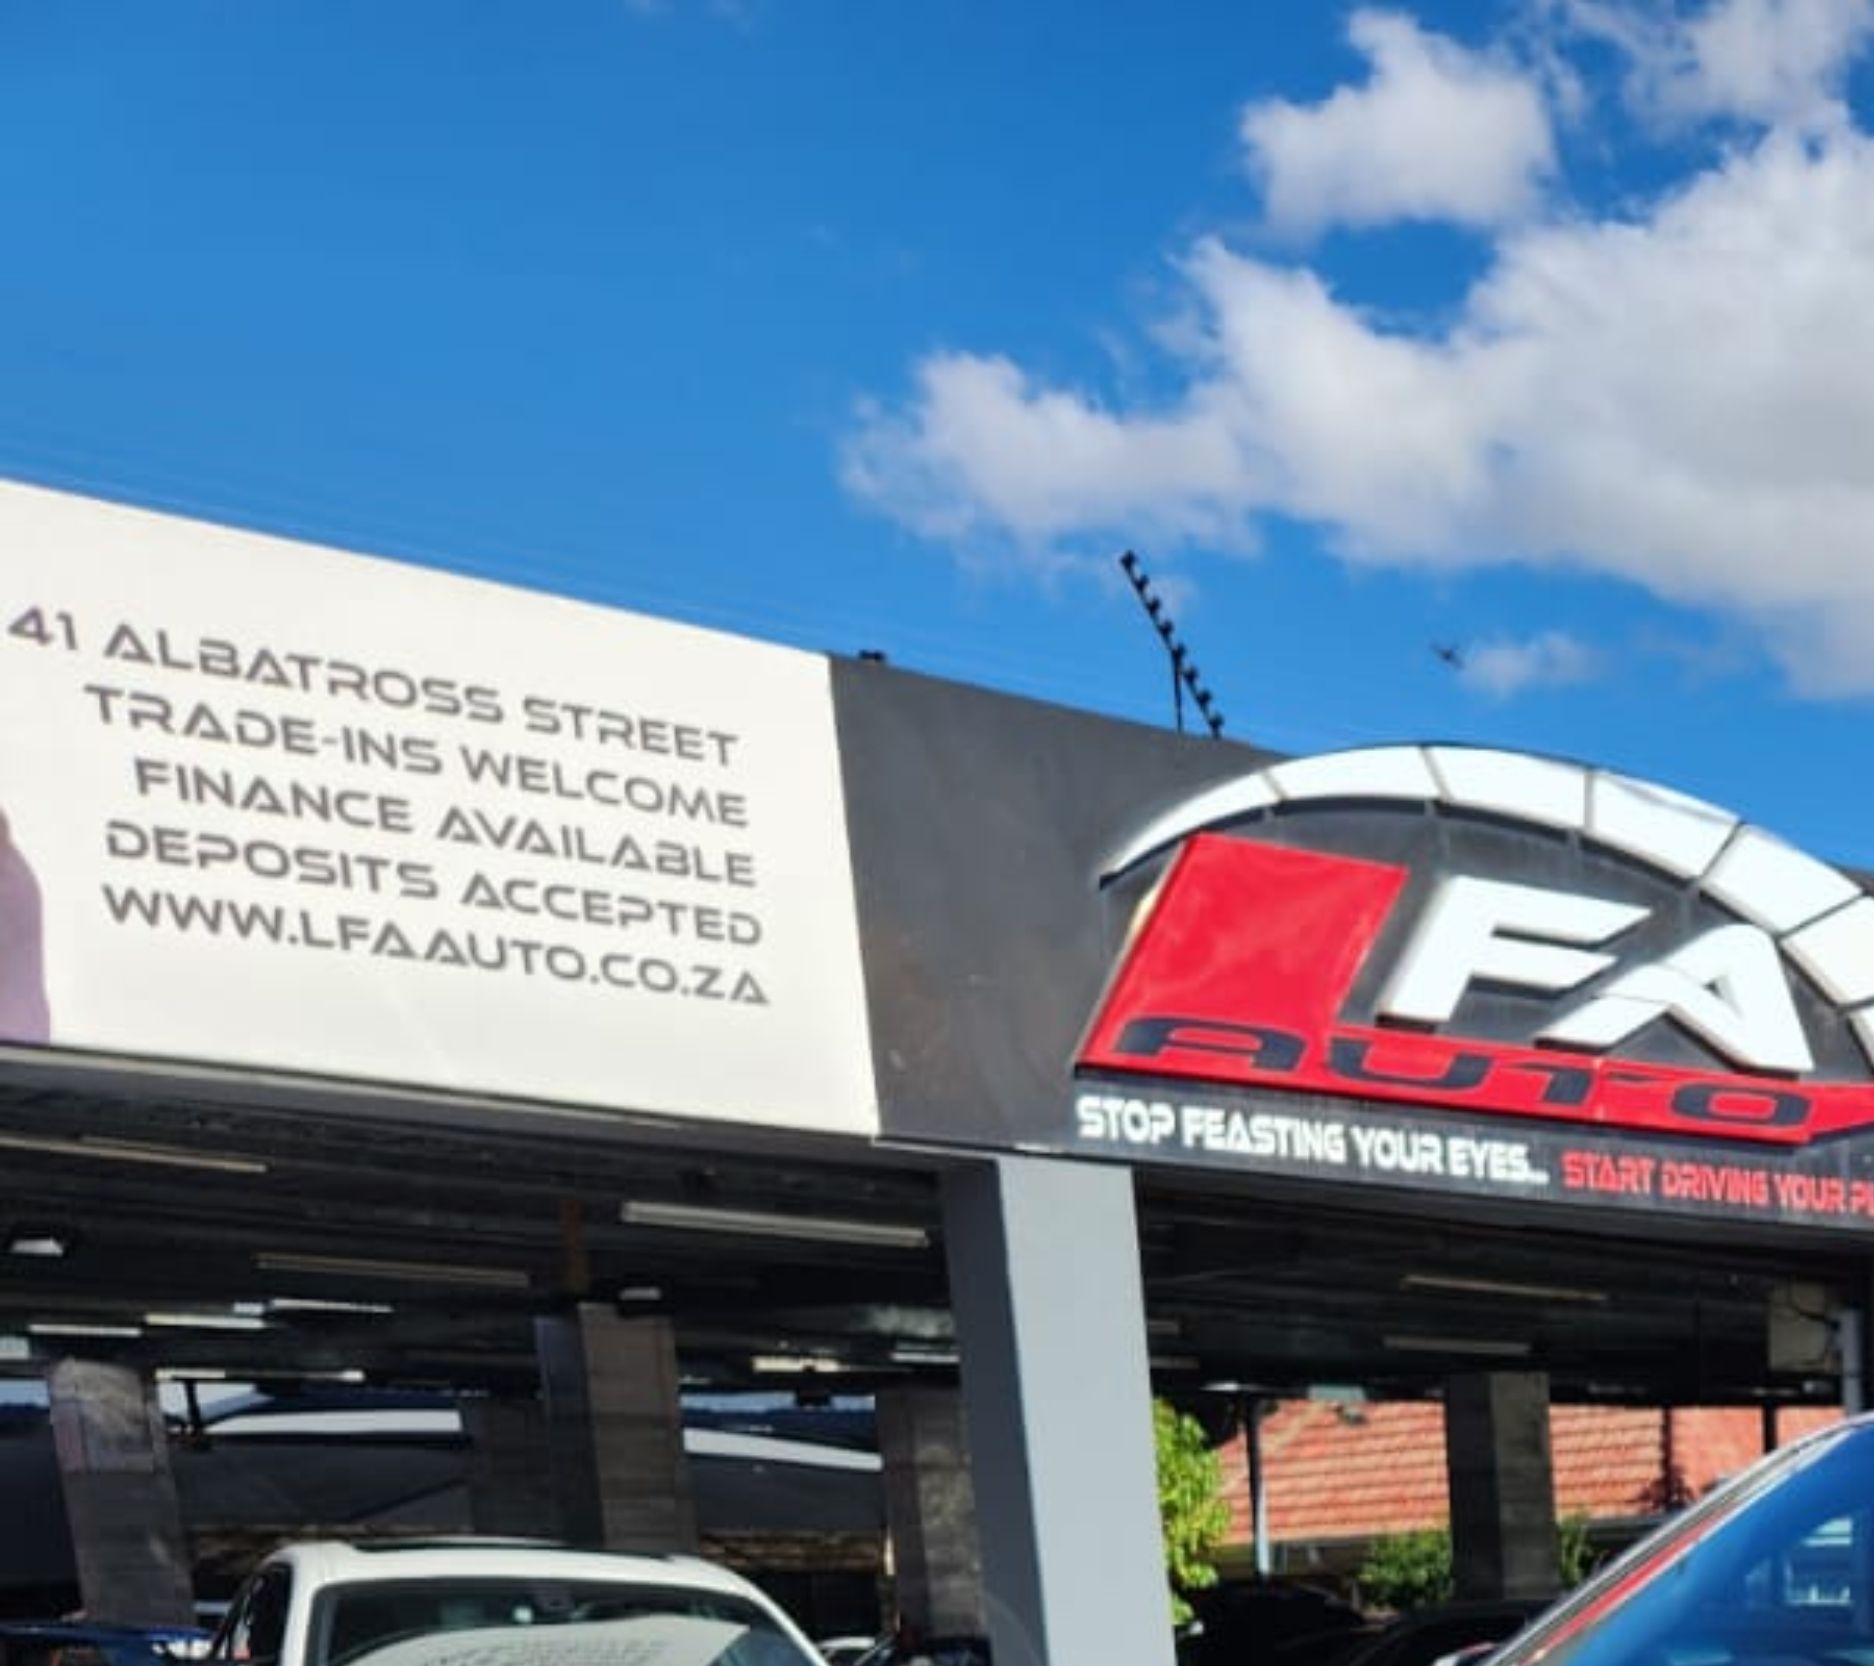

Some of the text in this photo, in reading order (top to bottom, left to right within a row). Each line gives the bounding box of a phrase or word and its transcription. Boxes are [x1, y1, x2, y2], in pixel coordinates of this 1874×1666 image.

[8, 607, 738, 766] 41 ALBATROSS STREET
[83, 684, 747, 828] TRADE-INS WELCOME
[106, 820, 762, 945] DEPOSITS ACCEPTED
[134, 758, 755, 887] FINANCE AVAILABLE
[102, 885, 769, 1005] WWW.LFAAUTO.CO.ZA
[1115, 1016, 1814, 1130] AUTO
[1075, 1094, 1176, 1145] STOP
[1180, 1105, 1347, 1164] FEASTING
[1351, 1125, 1445, 1175] YOUR
[1562, 1150, 1654, 1194] START
[1661, 1162, 1768, 1206] DRIVING
[1774, 1175, 1845, 1213] YOUR
